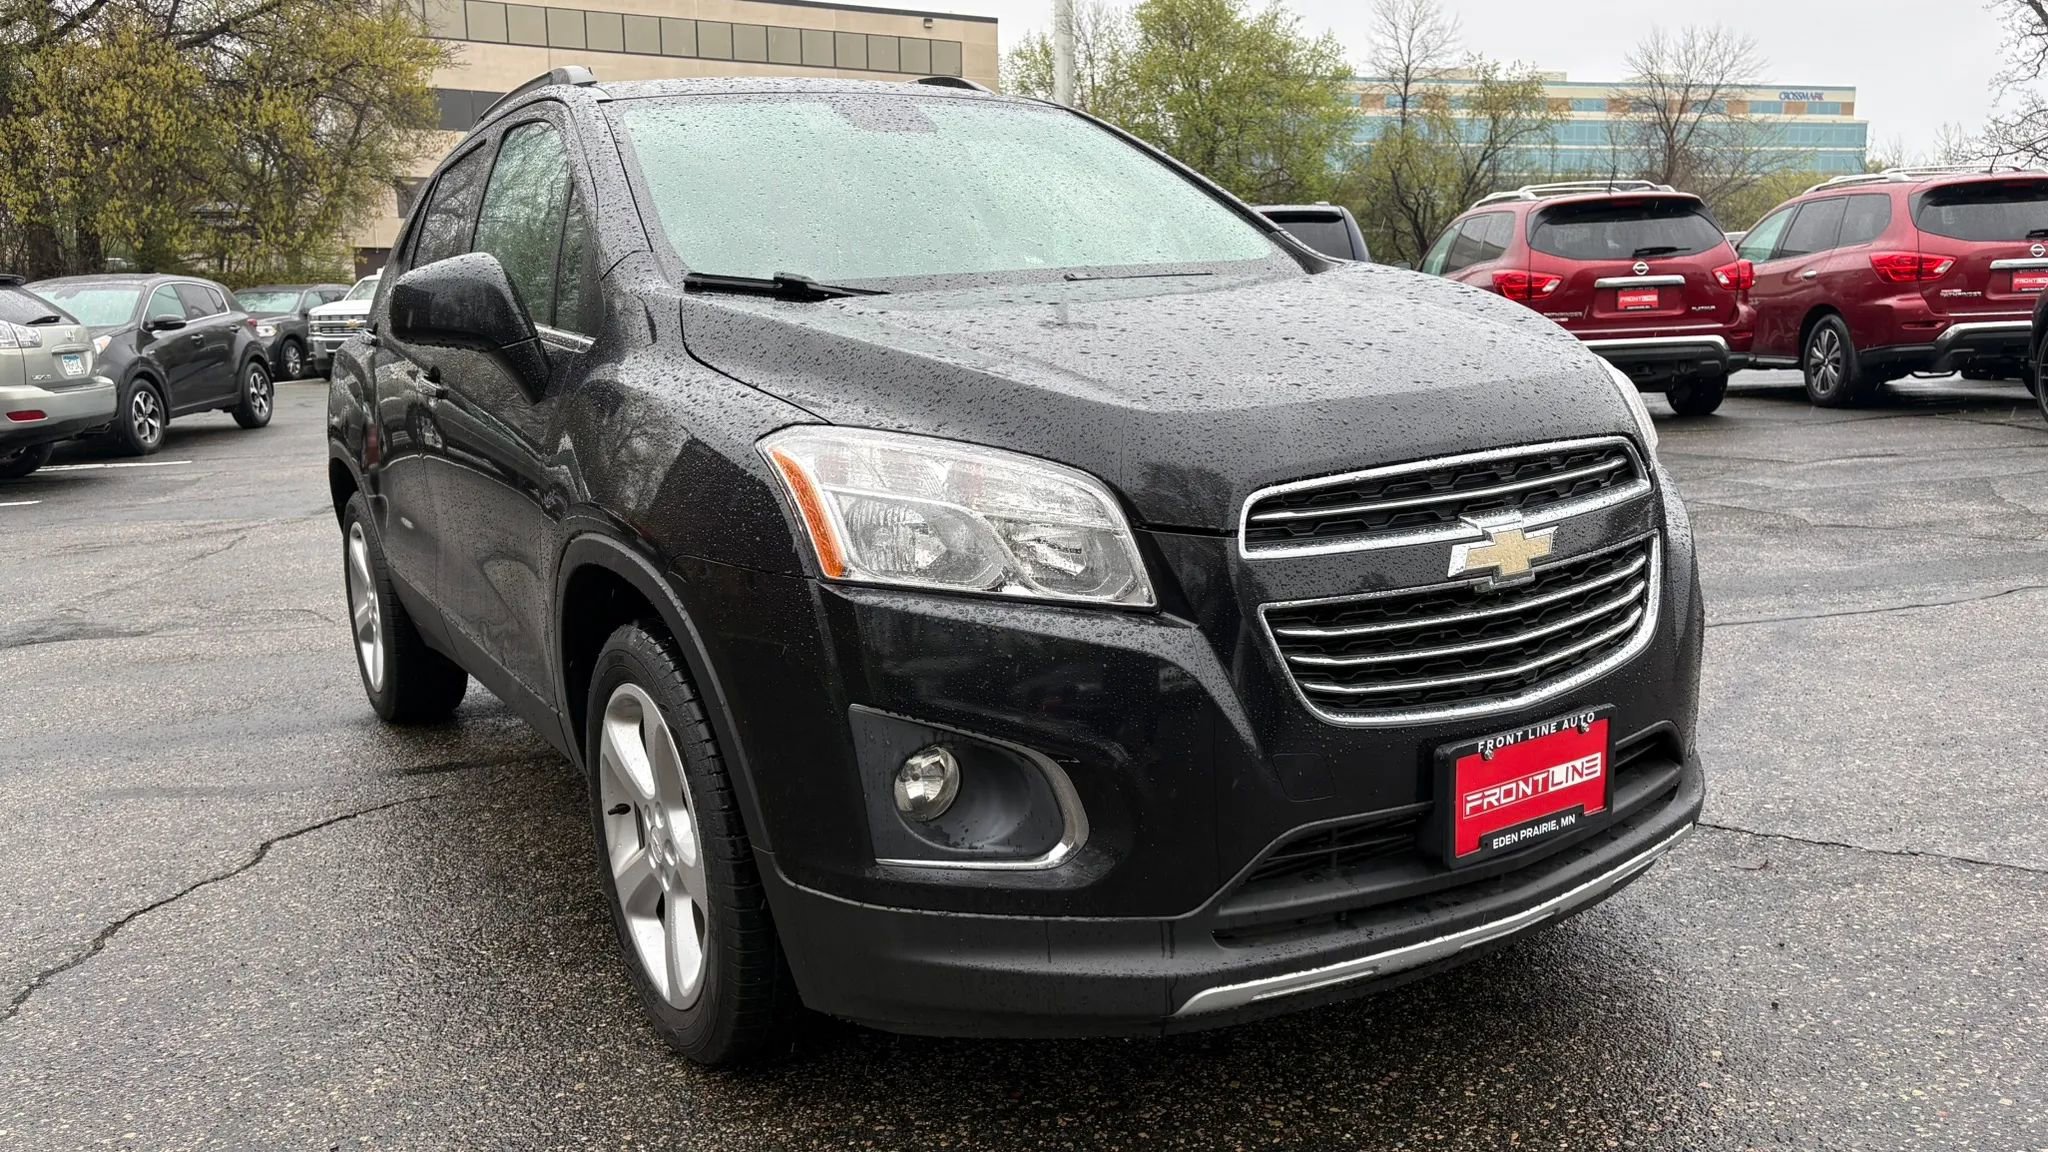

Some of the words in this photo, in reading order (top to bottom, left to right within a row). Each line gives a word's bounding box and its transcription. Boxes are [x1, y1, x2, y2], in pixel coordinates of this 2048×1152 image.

[1779, 91, 1825, 101] CROSSMARK
[1477, 731, 1523, 753] FRONT
[1528, 722, 1558, 740] LINE
[1562, 712, 1596, 730] AUTO
[1492, 832, 1519, 850] EDEN
[1520, 819, 1559, 842] PRAIRIE,
[1560, 814, 1576, 829] MN
